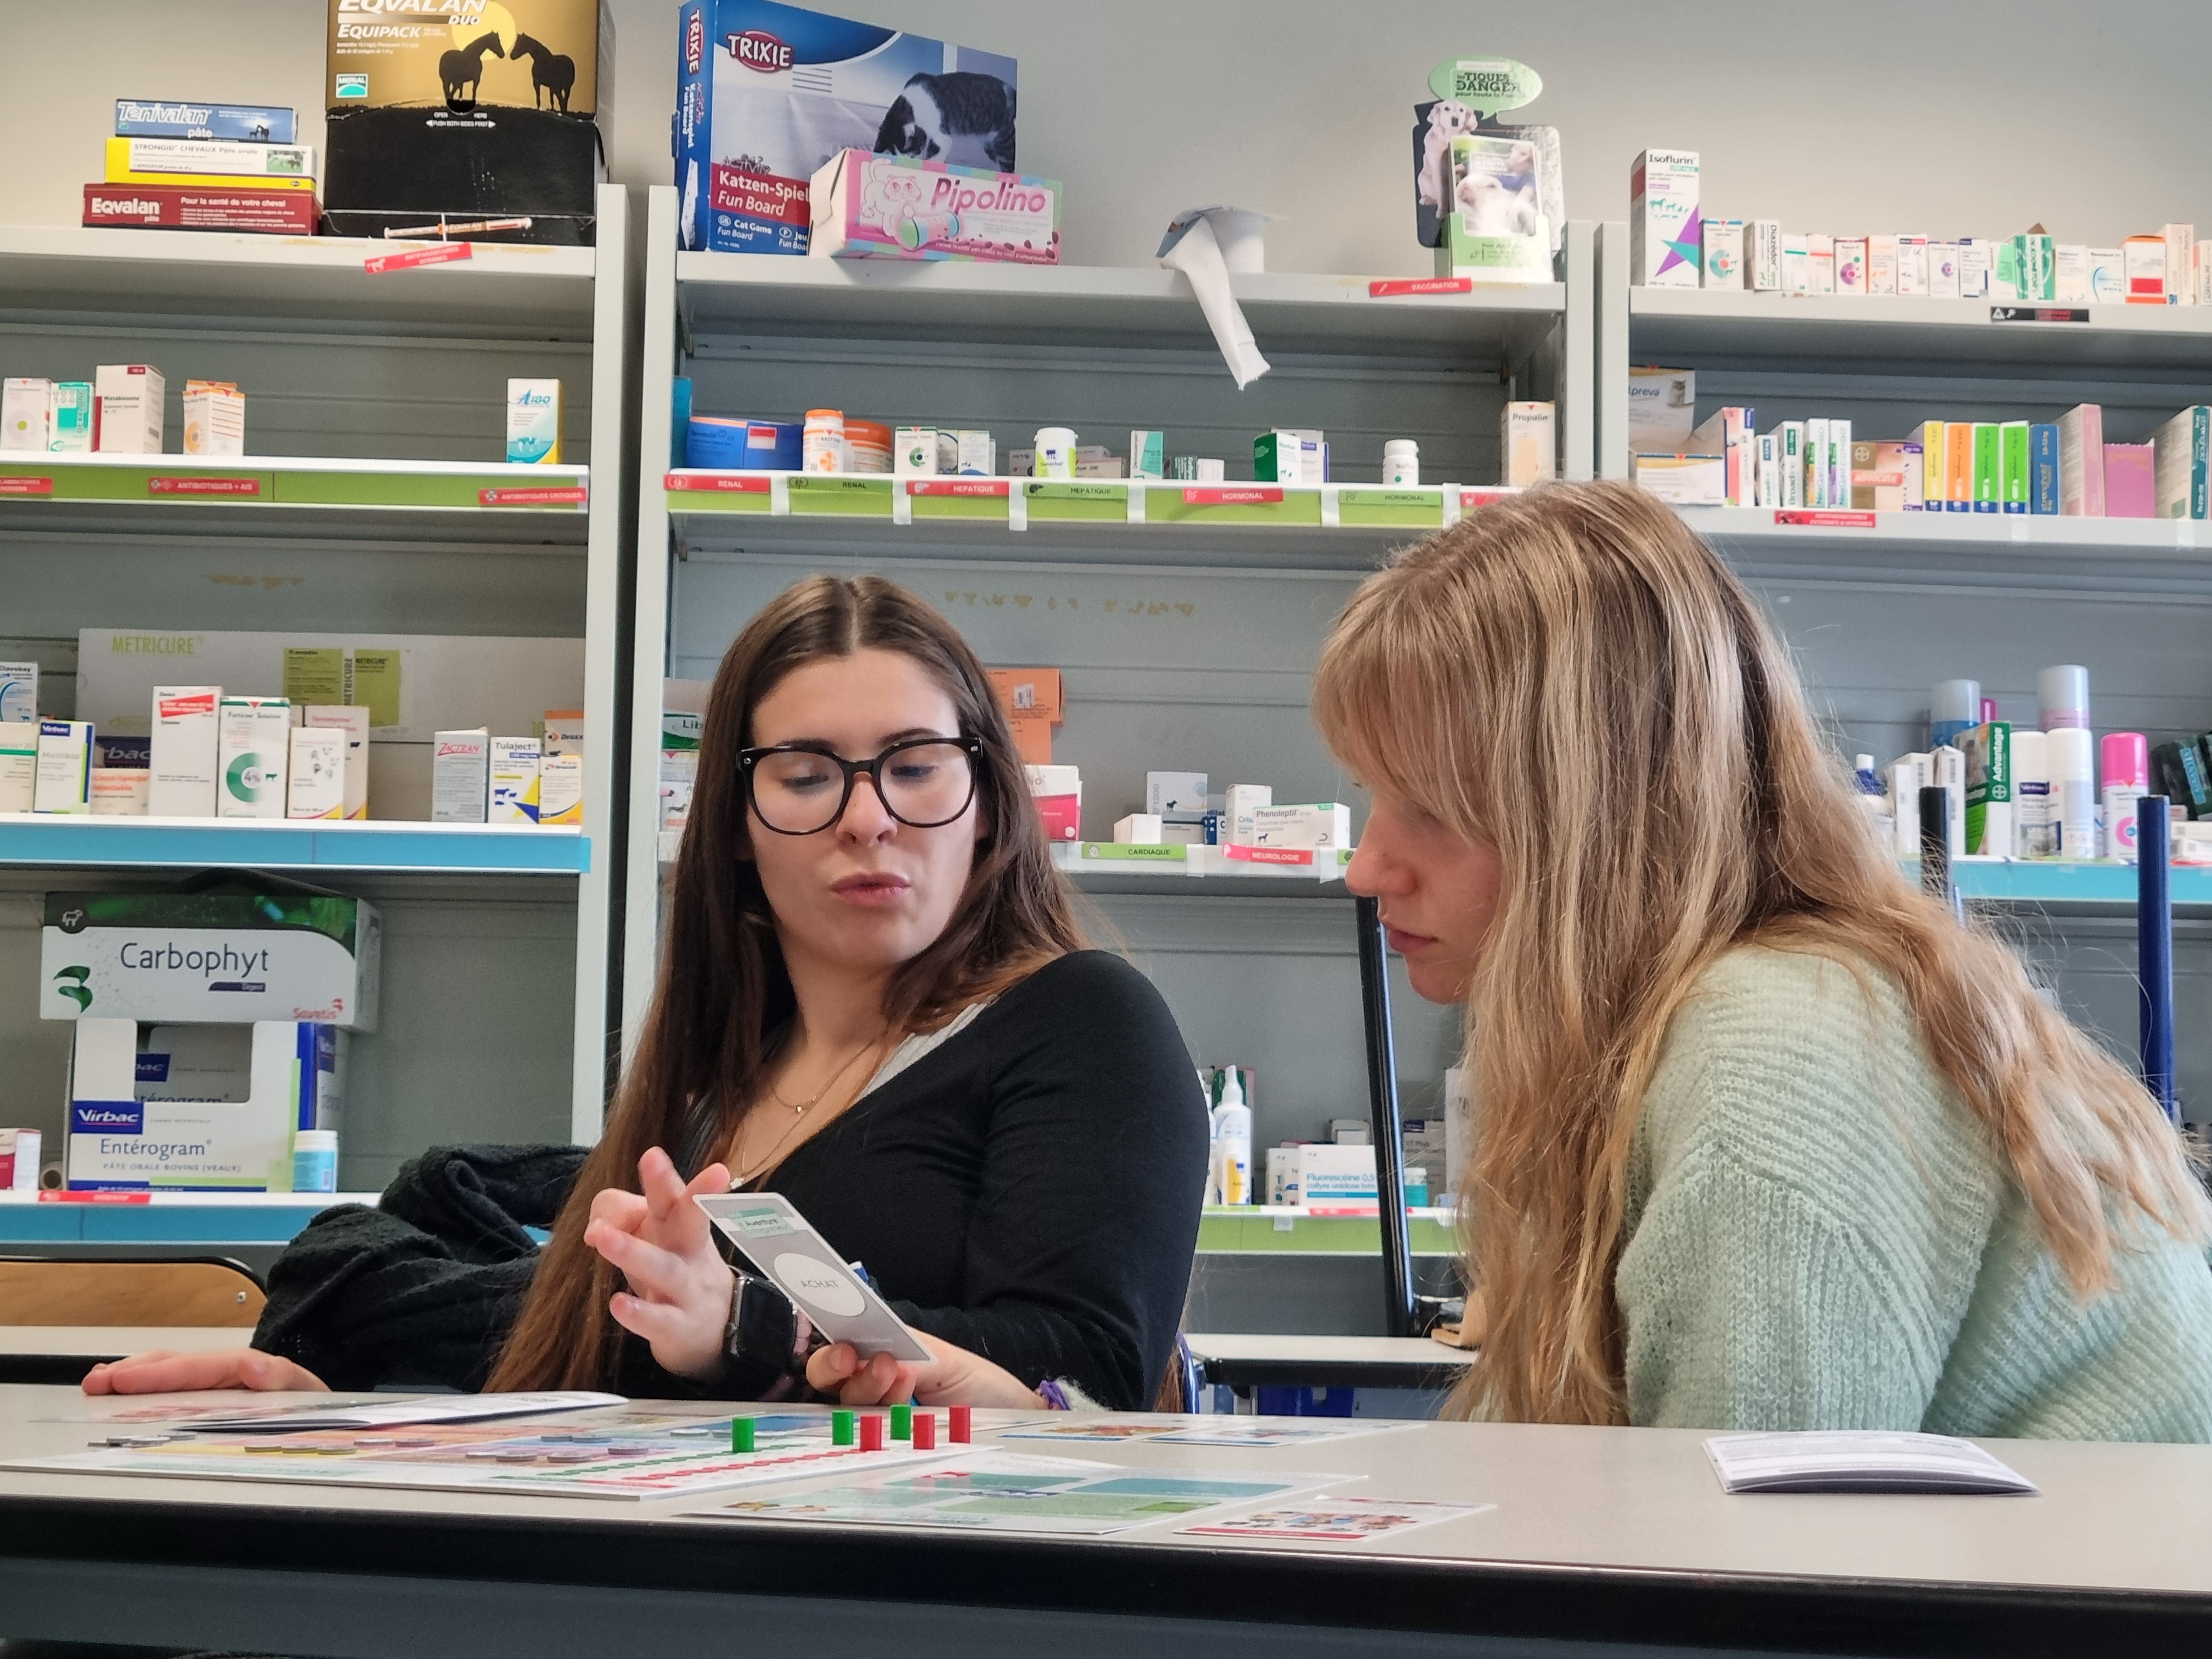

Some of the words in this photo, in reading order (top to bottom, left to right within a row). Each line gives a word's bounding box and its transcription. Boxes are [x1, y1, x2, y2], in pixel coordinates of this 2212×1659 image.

[448, 15, 481, 25] DUO
[337, 24, 421, 40] EQUIPACK
[689, 8, 700, 75] TRIXIE
[727, 33, 792, 69] TRIXIE
[1464, 72, 1509, 82] TIQUES
[117, 101, 208, 125] Tenivalan
[188, 128, 213, 138] pâte
[1649, 155, 1693, 165] Isoflurin
[930, 177, 1046, 216] Pipolino
[92, 198, 160, 215] Eqvalan
[718, 190, 743, 208] Fun
[745, 195, 785, 217] Board
[734, 220, 748, 230] Cat
[749, 222, 772, 235] Game
[718, 227, 731, 236] Fun
[732, 230, 753, 241] Board
[794, 231, 807, 241] Jeu
[779, 239, 792, 248] Fun
[793, 242, 807, 251] Boa
[1411, 281, 1460, 291] VACCINATION
[1629, 387, 1660, 397] lpreva
[1513, 413, 1548, 422] Propalin
[1854, 473, 1898, 482] advocate
[112, 636, 195, 654] METRICURE
[42, 724, 69, 733] Virbac
[682, 720, 702, 730] Lib
[438, 743, 479, 756] ZACTRAN
[495, 742, 532, 751] Tulaject
[104, 747, 151, 760] rbac
[1993, 726, 2004, 781] Advantage
[1256, 809, 1297, 818] Phenoleptil
[1252, 851, 1300, 861] NEUROLOGIE
[120, 942, 269, 978] Carbophyt
[137, 1063, 163, 1071] bac
[78, 1109, 139, 1122] Virbac
[101, 1138, 205, 1160] Entérogram
[104, 1161, 125, 1170] PÂTE
[202, 1164, 241, 1172] (VEAUX)
[800, 1280, 839, 1288] ACHAT
